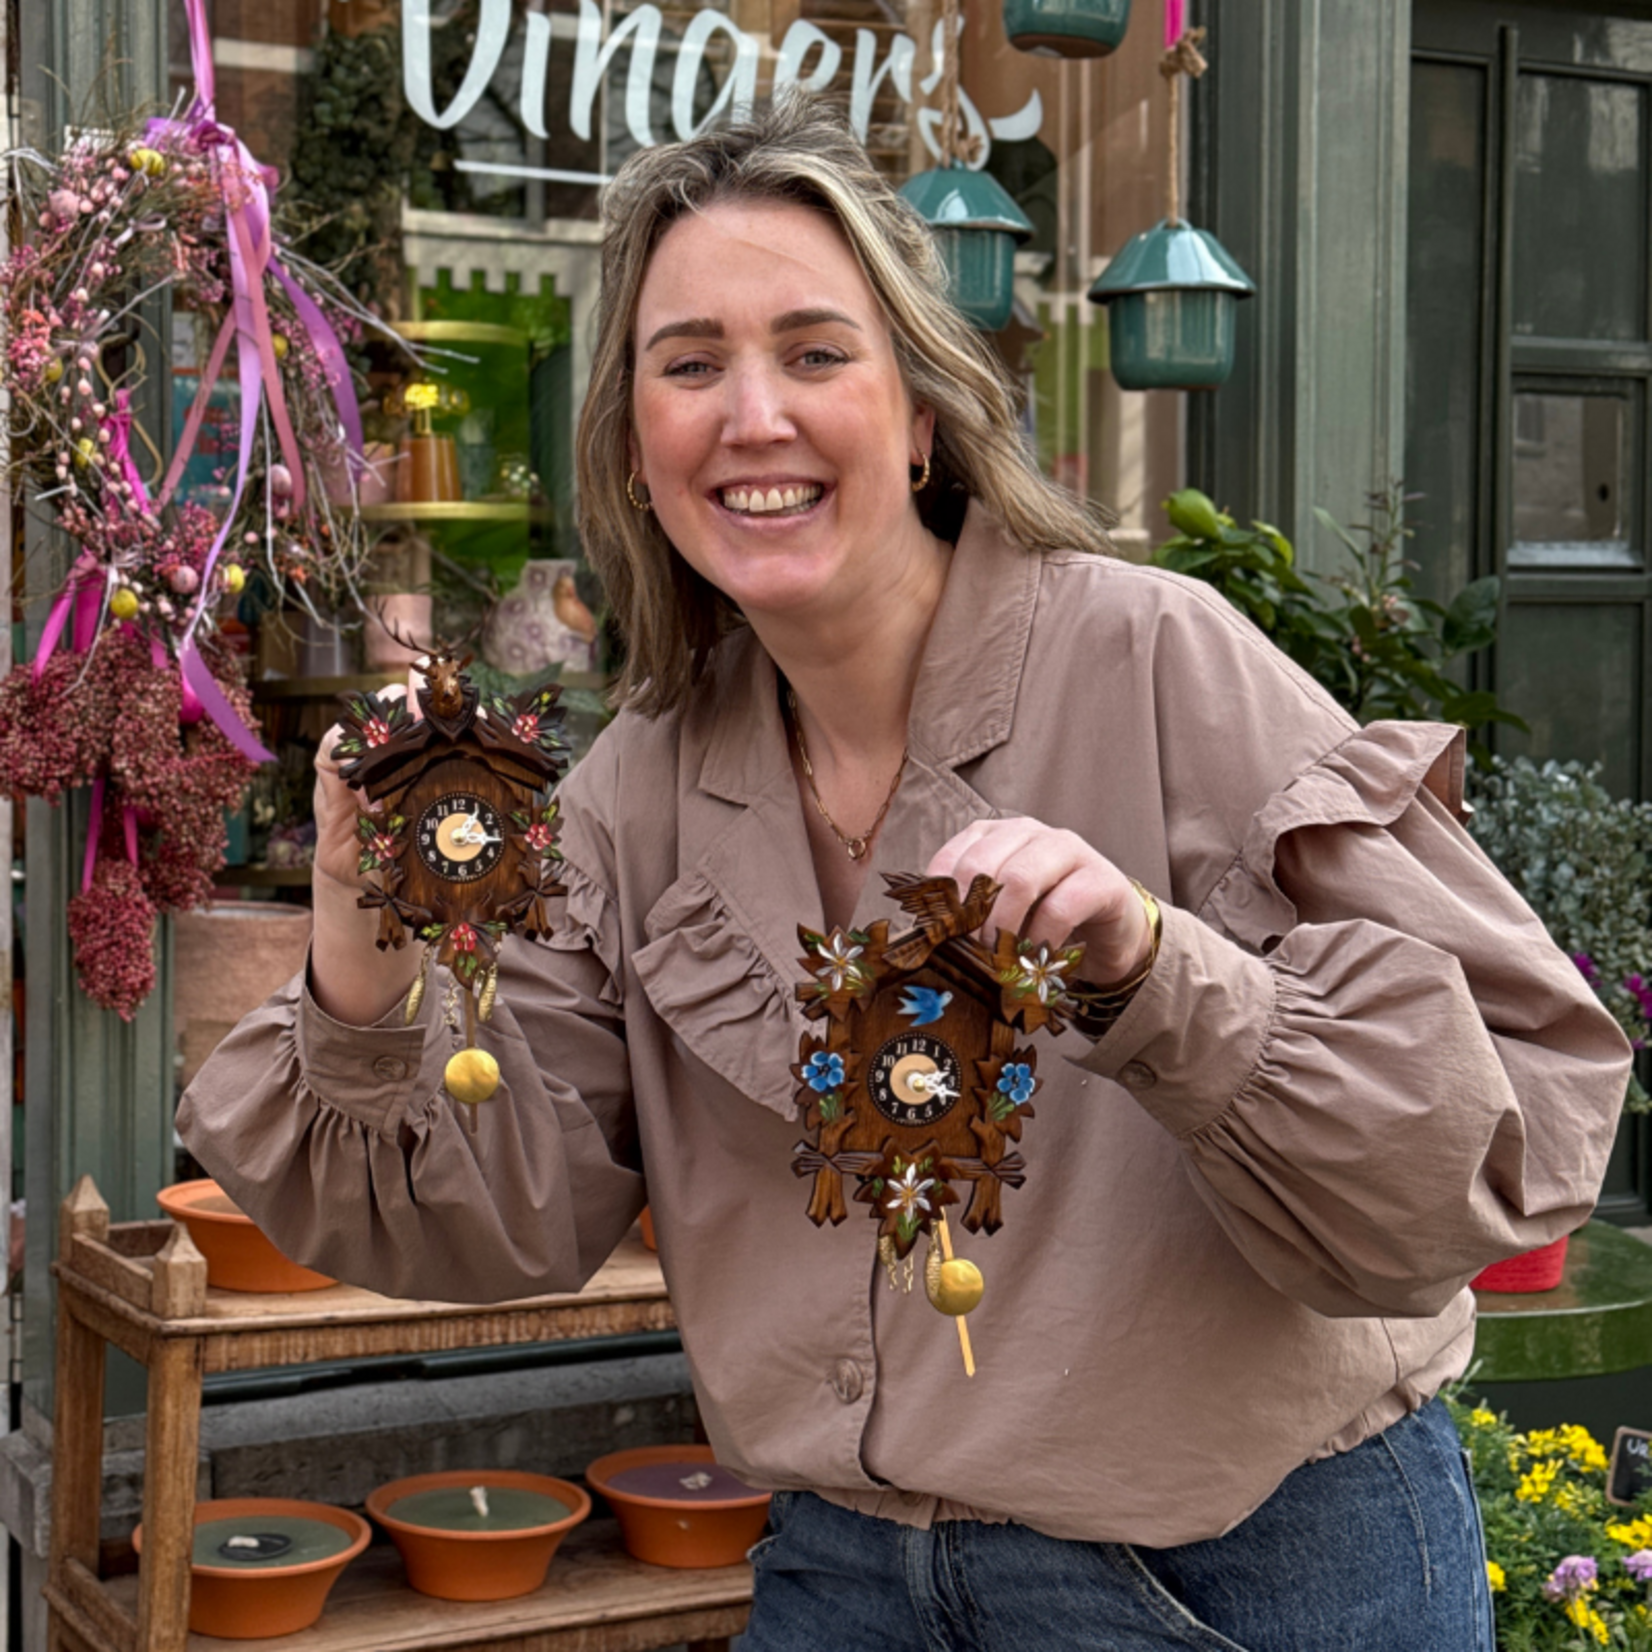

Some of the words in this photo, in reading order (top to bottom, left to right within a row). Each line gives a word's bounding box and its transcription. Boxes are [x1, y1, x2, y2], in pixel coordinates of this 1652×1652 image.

[437, 804, 449, 816] 11
[452, 799, 466, 811] 12
[425, 818, 439, 830] 10
[485, 813, 494, 825] 2
[420, 833, 430, 846] 9
[428, 850, 437, 862] 8
[487, 847, 494, 858] 4
[441, 860, 449, 874] 7
[457, 864, 467, 877] 6
[475, 859, 483, 872] 5
[896, 1042, 907, 1055] 11
[911, 1038, 926, 1052] 12
[933, 1044, 940, 1058] 1
[882, 1054, 895, 1067] 10
[943, 1058, 952, 1071] 2
[875, 1069, 885, 1083] 9
[947, 1075, 955, 1088] 3
[879, 1088, 887, 1101] 8
[891, 1102, 899, 1114] 7
[906, 1107, 916, 1120] 6
[924, 1104, 933, 1118] 5
